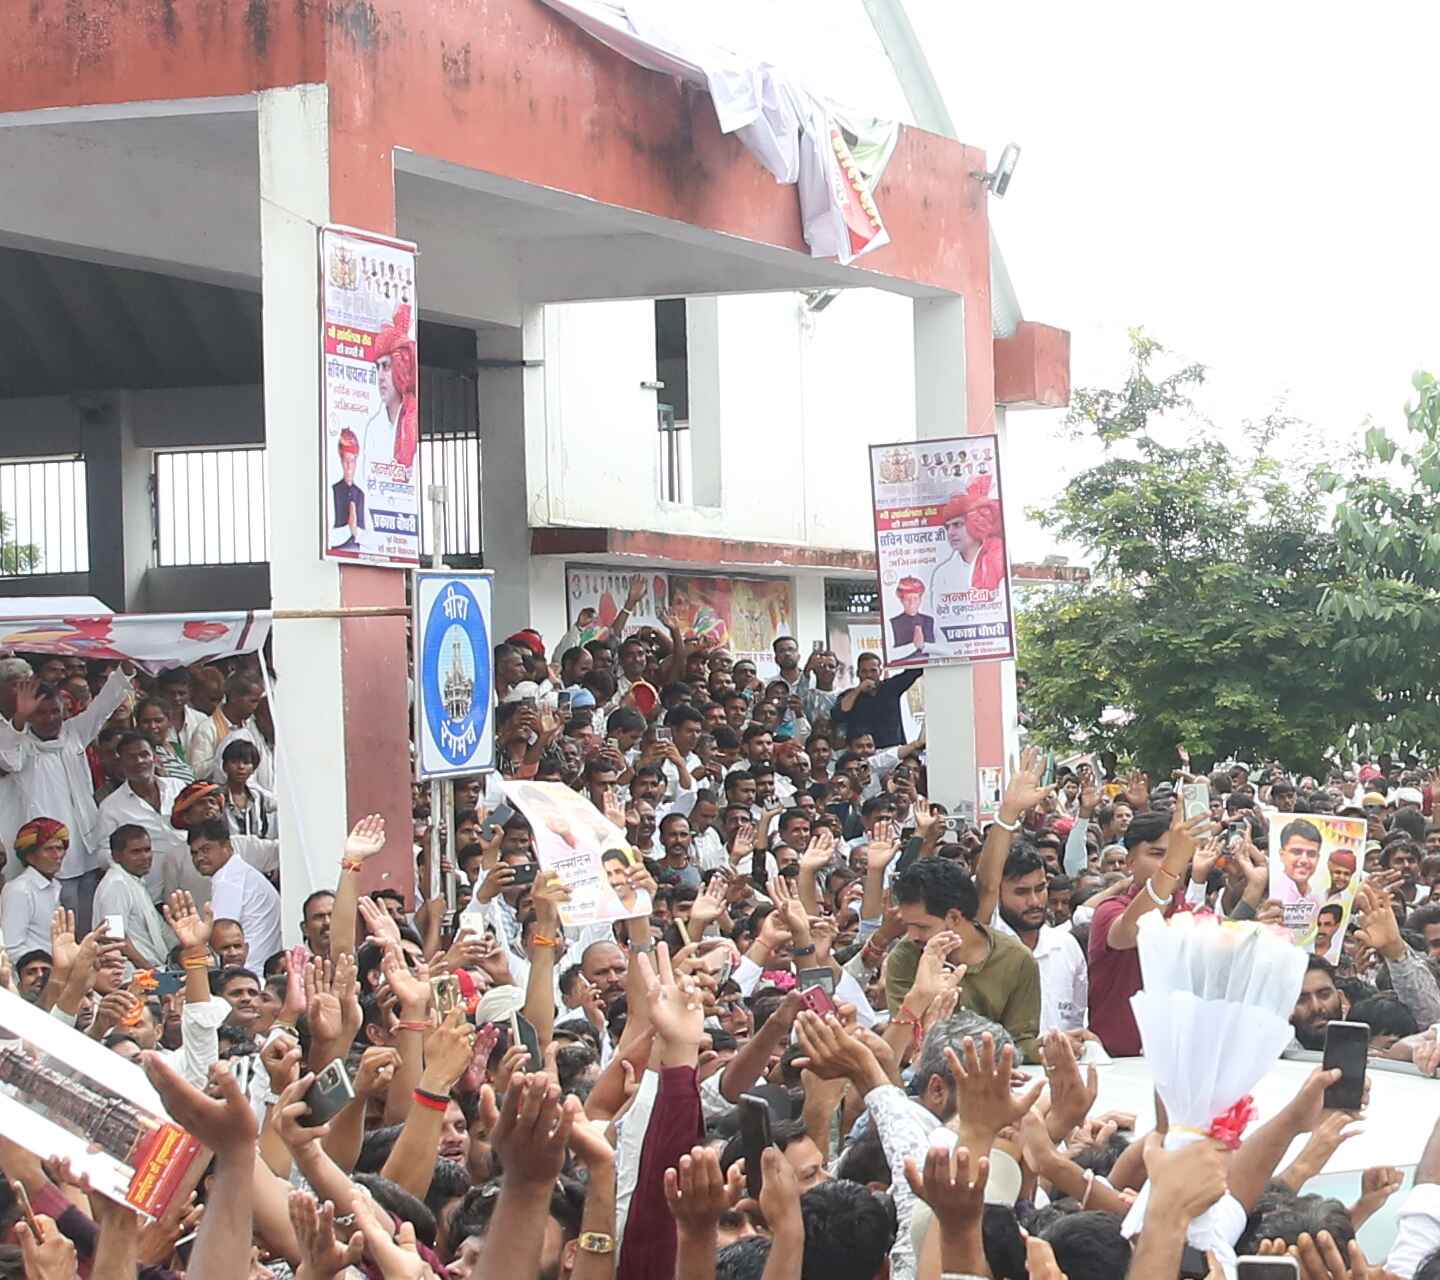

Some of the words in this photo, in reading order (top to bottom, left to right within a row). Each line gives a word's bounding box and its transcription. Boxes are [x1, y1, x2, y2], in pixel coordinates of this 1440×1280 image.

[904, 529, 934, 545] पायलट
[934, 527, 947, 543] जी
[442, 586, 470, 621] मीरा
[440, 719, 478, 760] रंगमंच
